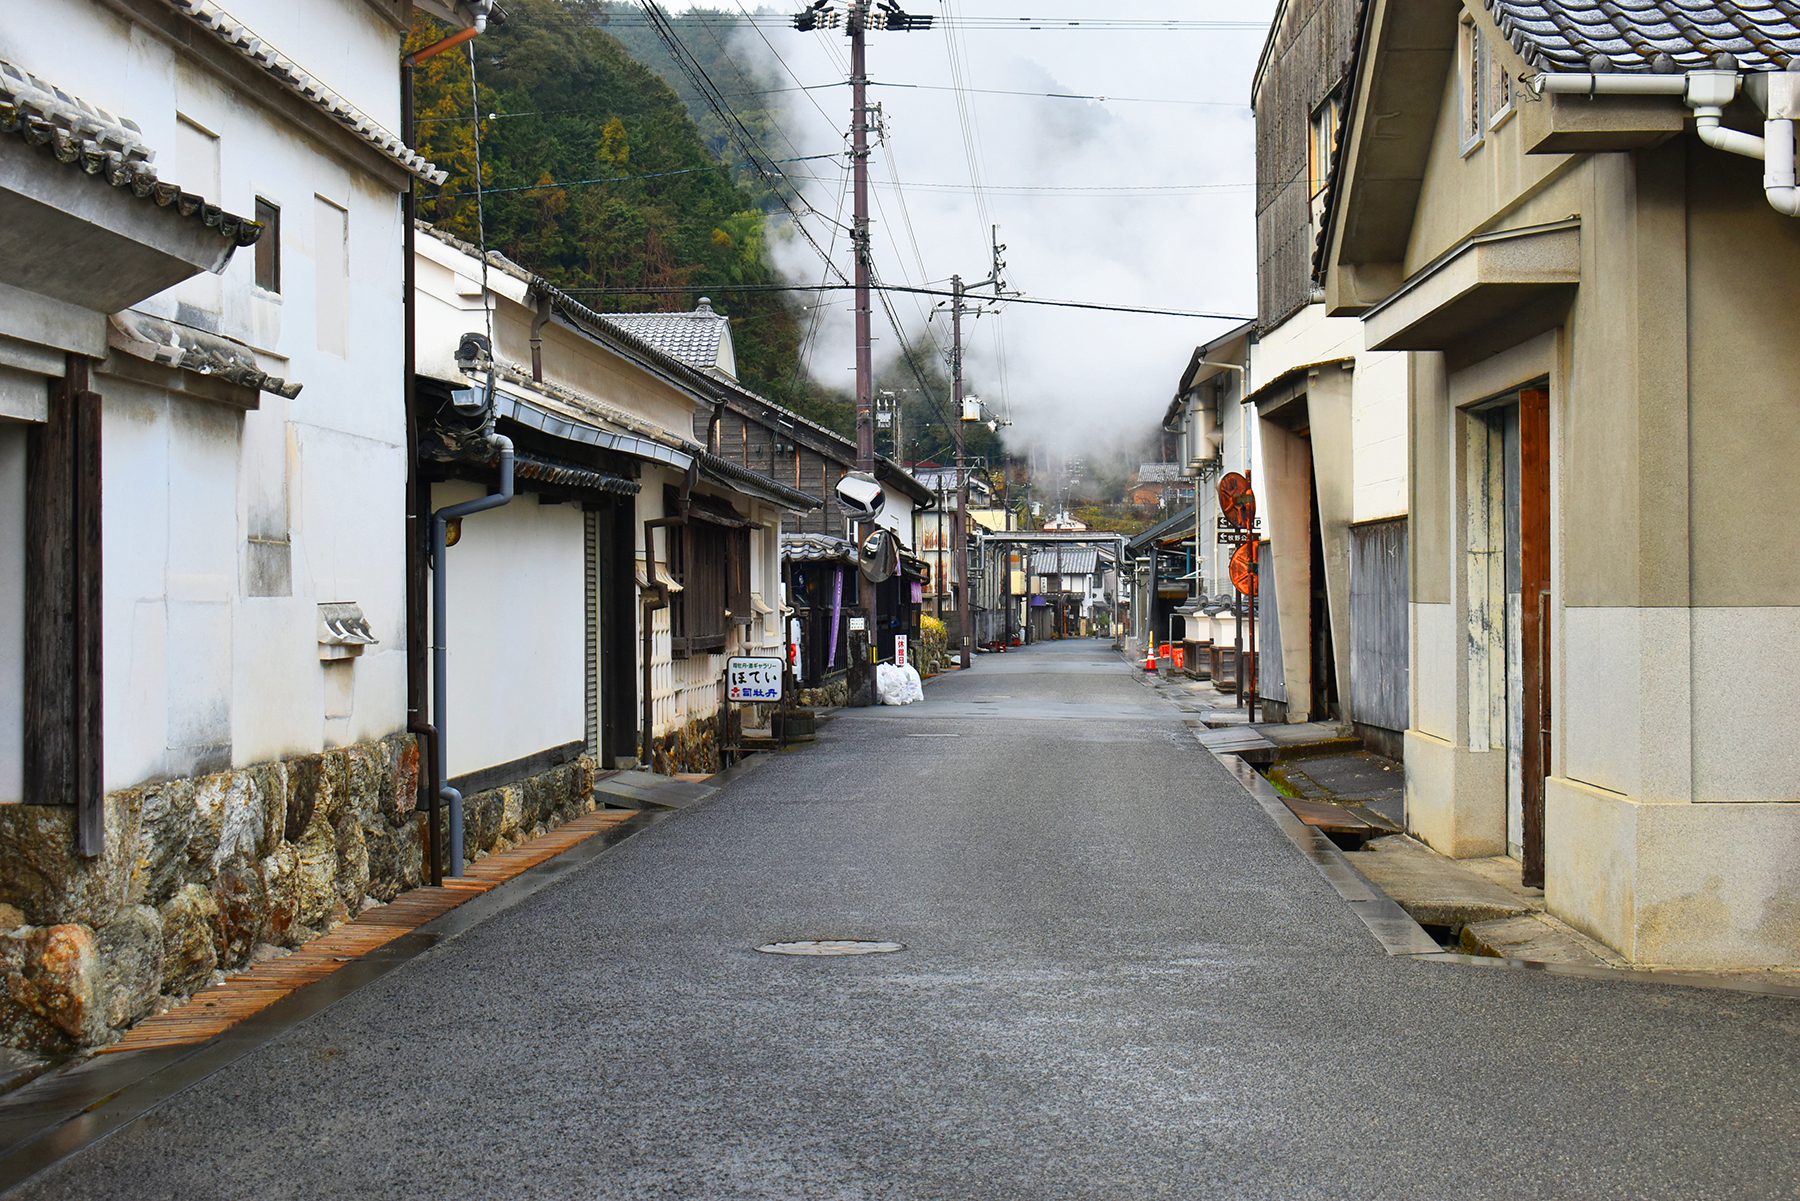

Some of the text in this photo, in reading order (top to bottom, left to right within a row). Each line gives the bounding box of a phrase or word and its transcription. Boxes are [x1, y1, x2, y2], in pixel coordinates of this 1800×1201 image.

[732, 671, 777, 685] ほてい
[742, 688, 778, 697] 司牡丹
